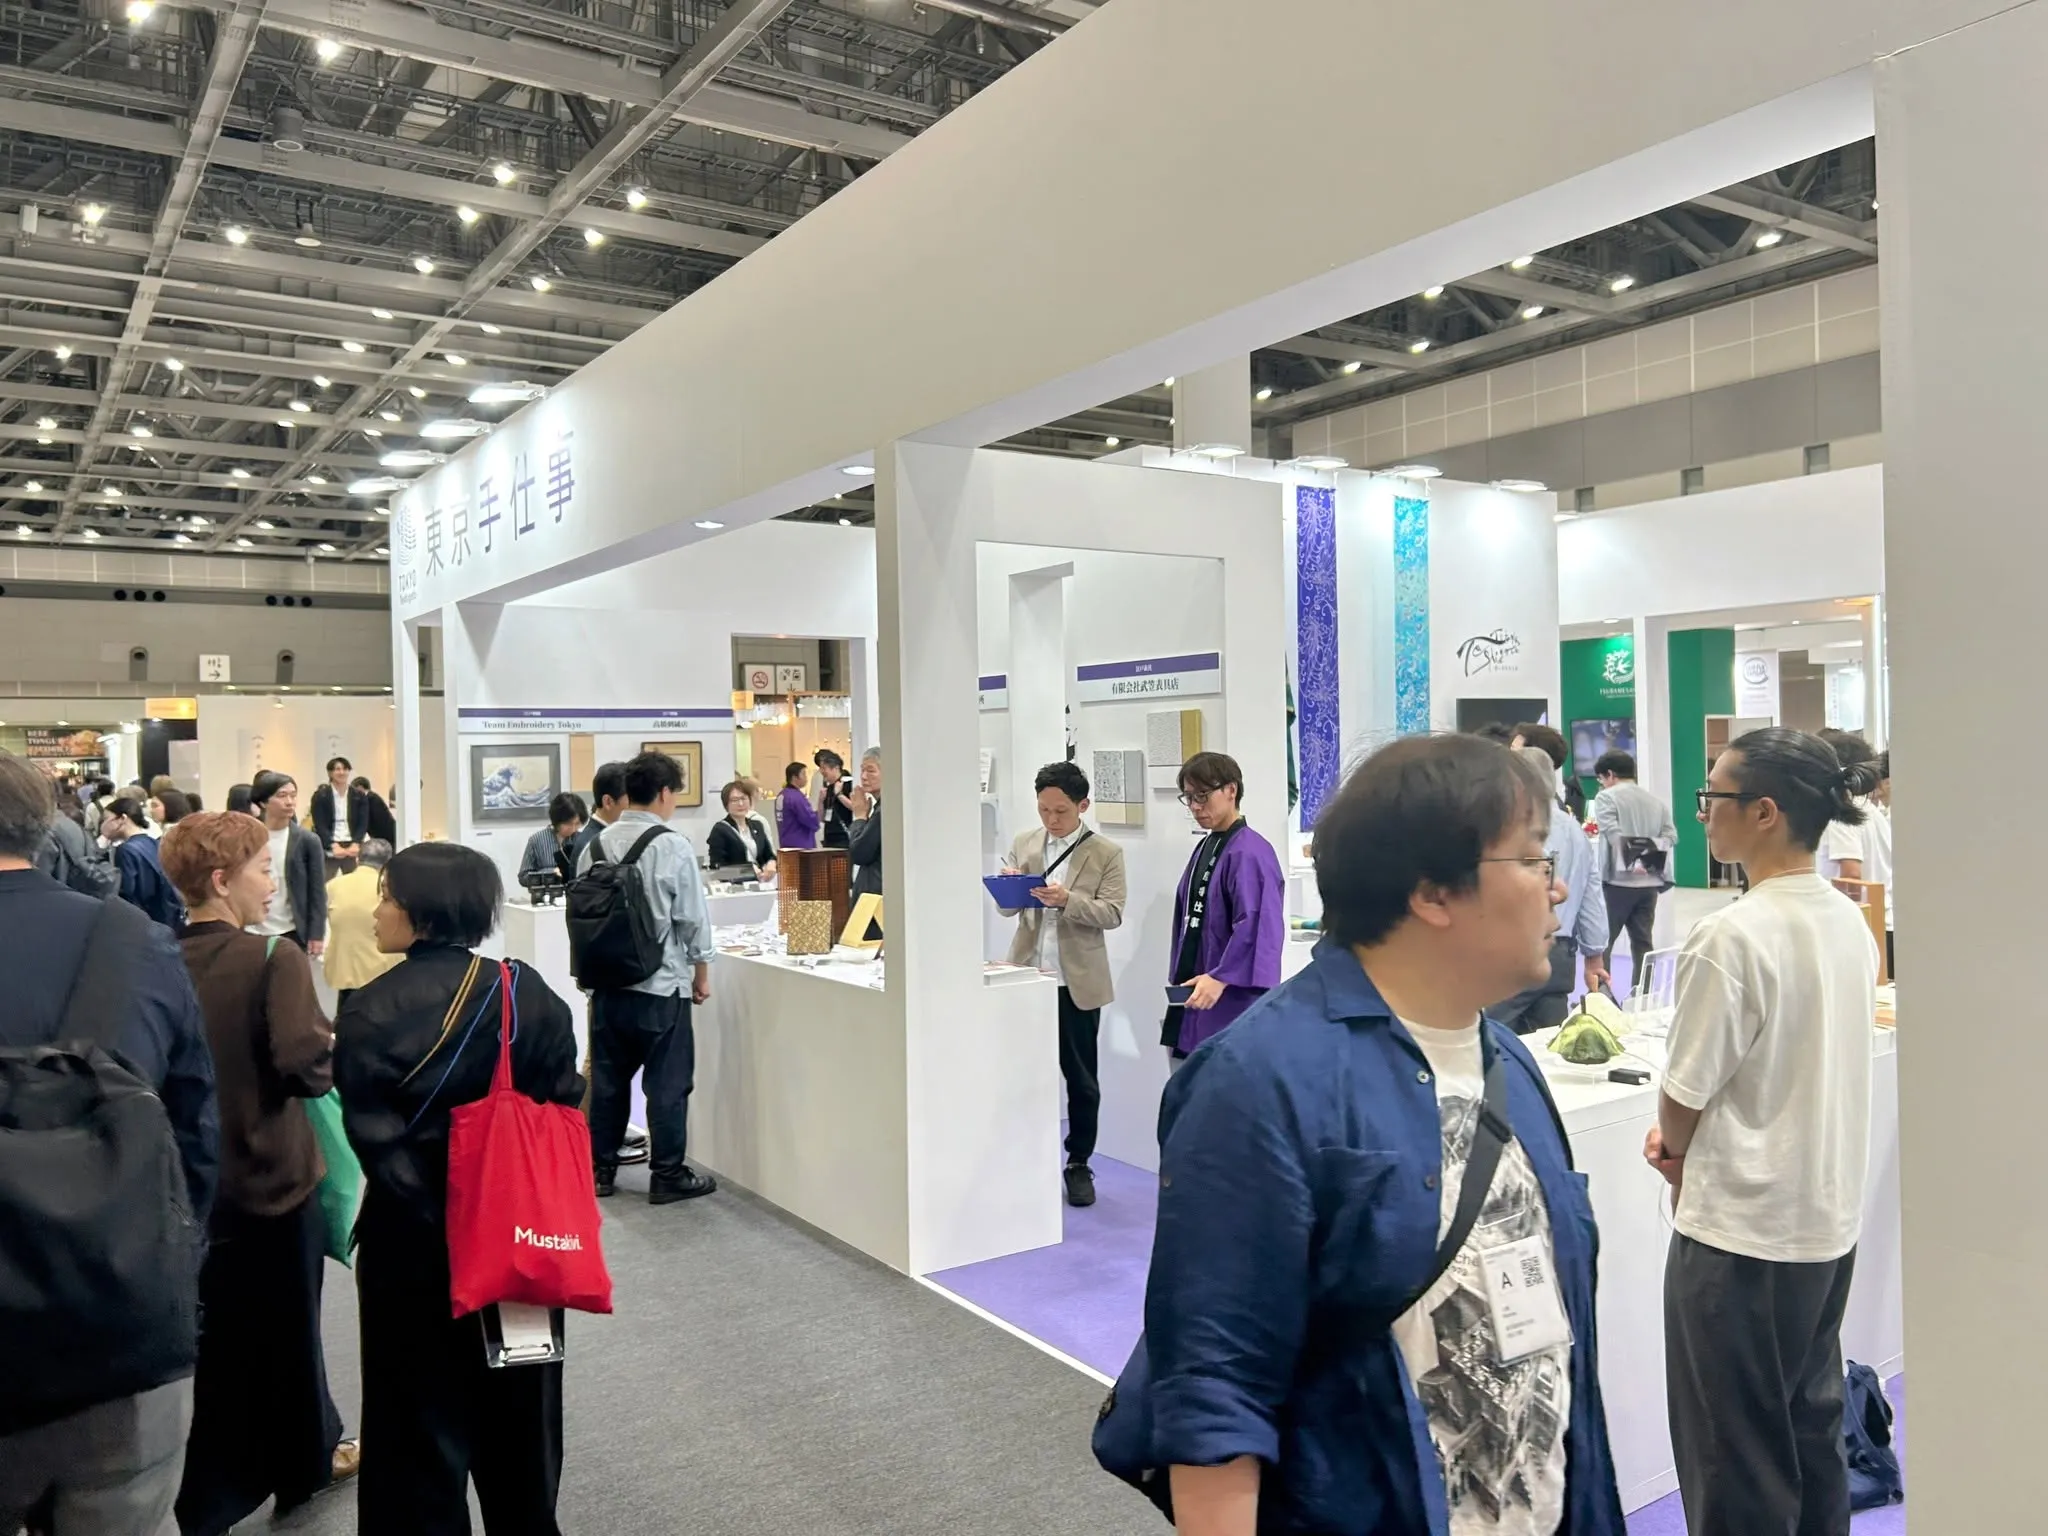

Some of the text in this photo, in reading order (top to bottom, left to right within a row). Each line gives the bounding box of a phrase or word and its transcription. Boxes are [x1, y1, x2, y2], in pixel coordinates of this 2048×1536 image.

[425, 430, 576, 577] 東京手仕事
[482, 720, 582, 730] Team Embroidery Tokyo
[1501, 1271, 1513, 1289] A
